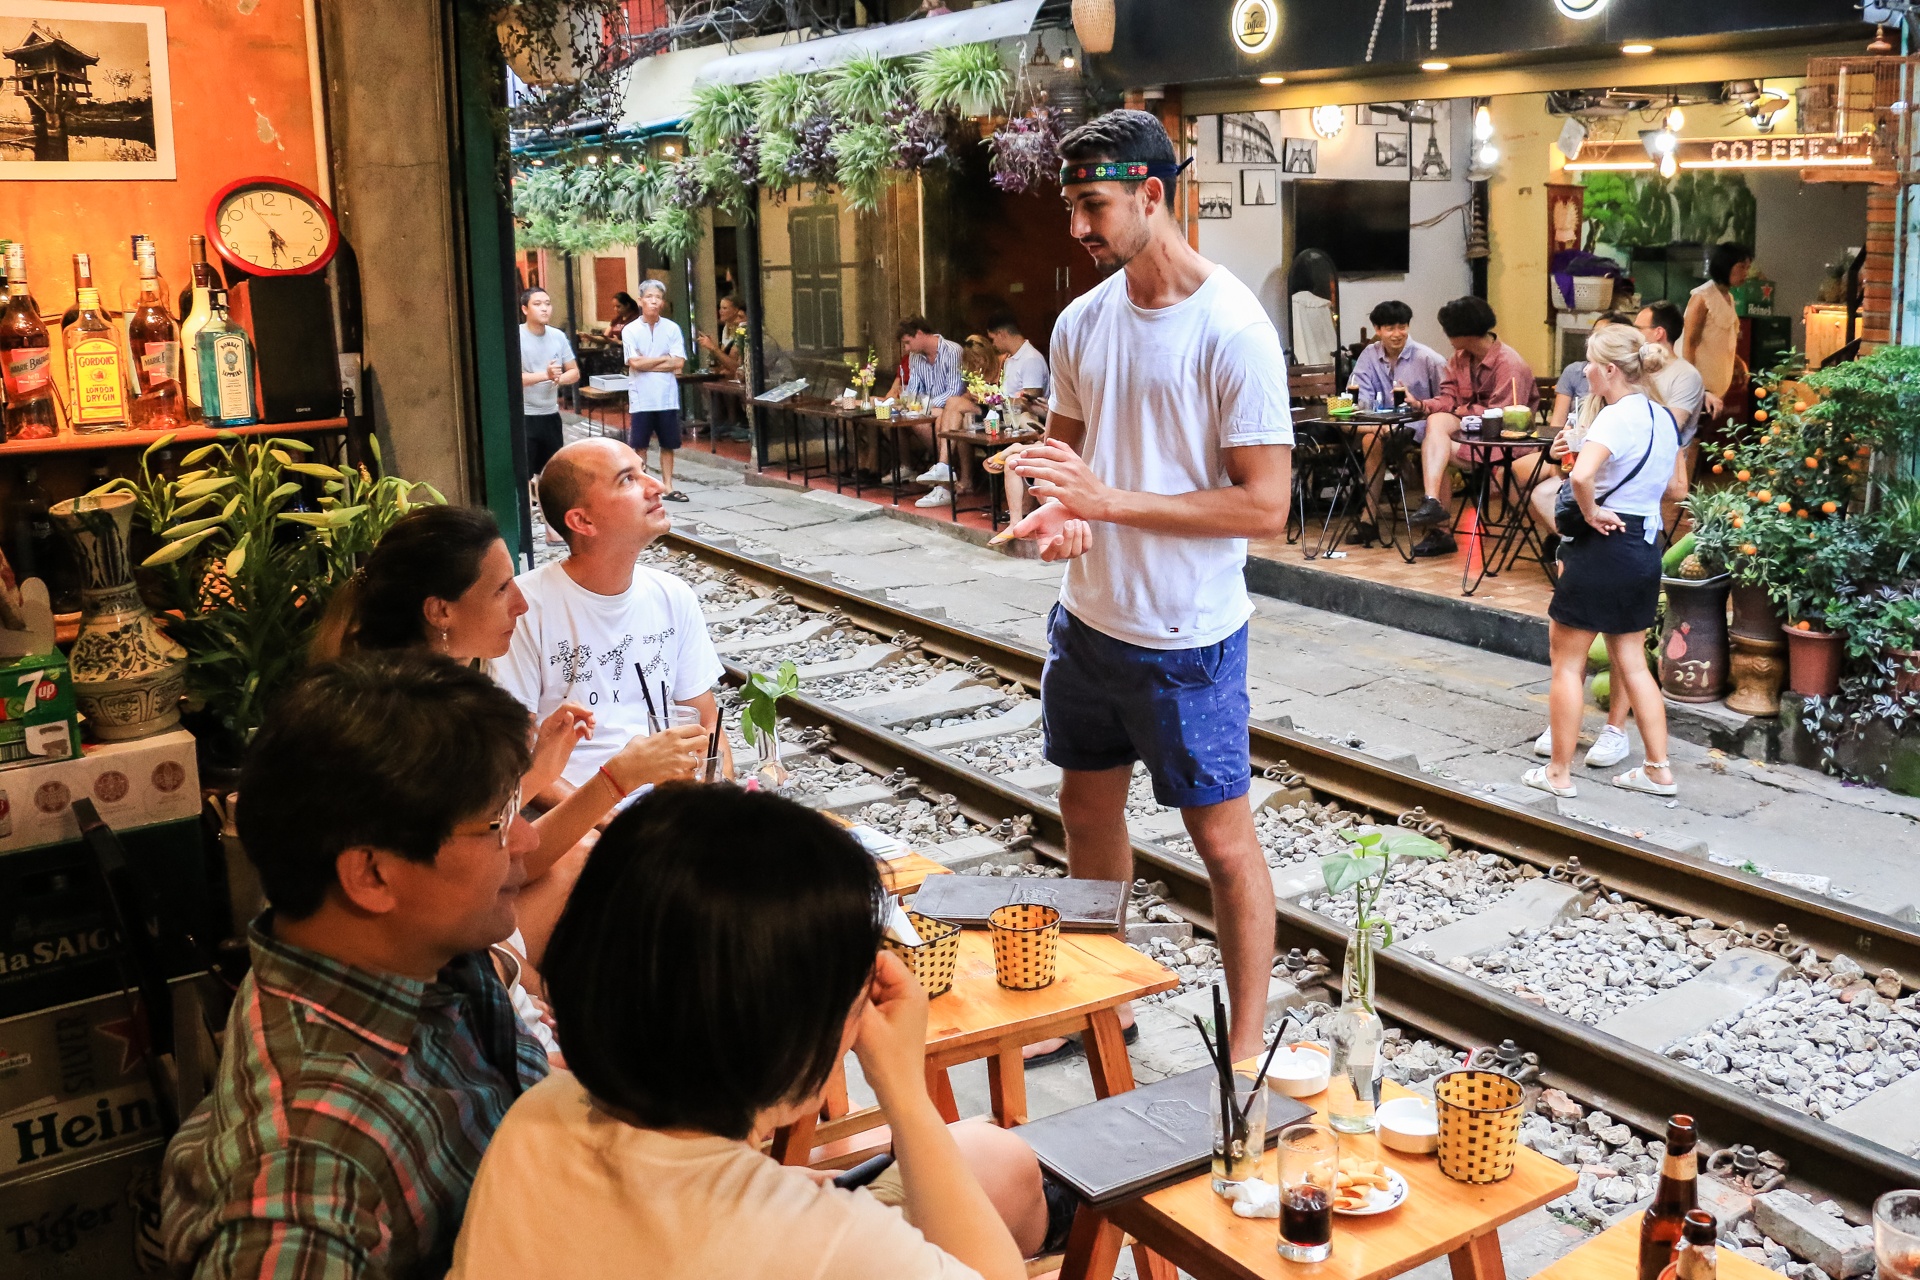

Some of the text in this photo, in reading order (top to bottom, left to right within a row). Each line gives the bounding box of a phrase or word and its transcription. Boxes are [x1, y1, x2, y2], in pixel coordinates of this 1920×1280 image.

[242, 197, 254, 210] 11
[260, 193, 275, 206] 12
[288, 197, 293, 211] 1
[225, 208, 243, 221] 10
[302, 210, 314, 225] 2
[219, 224, 231, 237] 9
[312, 227, 324, 241] 3
[230, 242, 240, 255] 8
[307, 245, 318, 258] 4
[86, 386, 114, 394] LONDON
[86, 393, 115, 402] DRY GIN
[4, 1202, 119, 1255] Tiger
